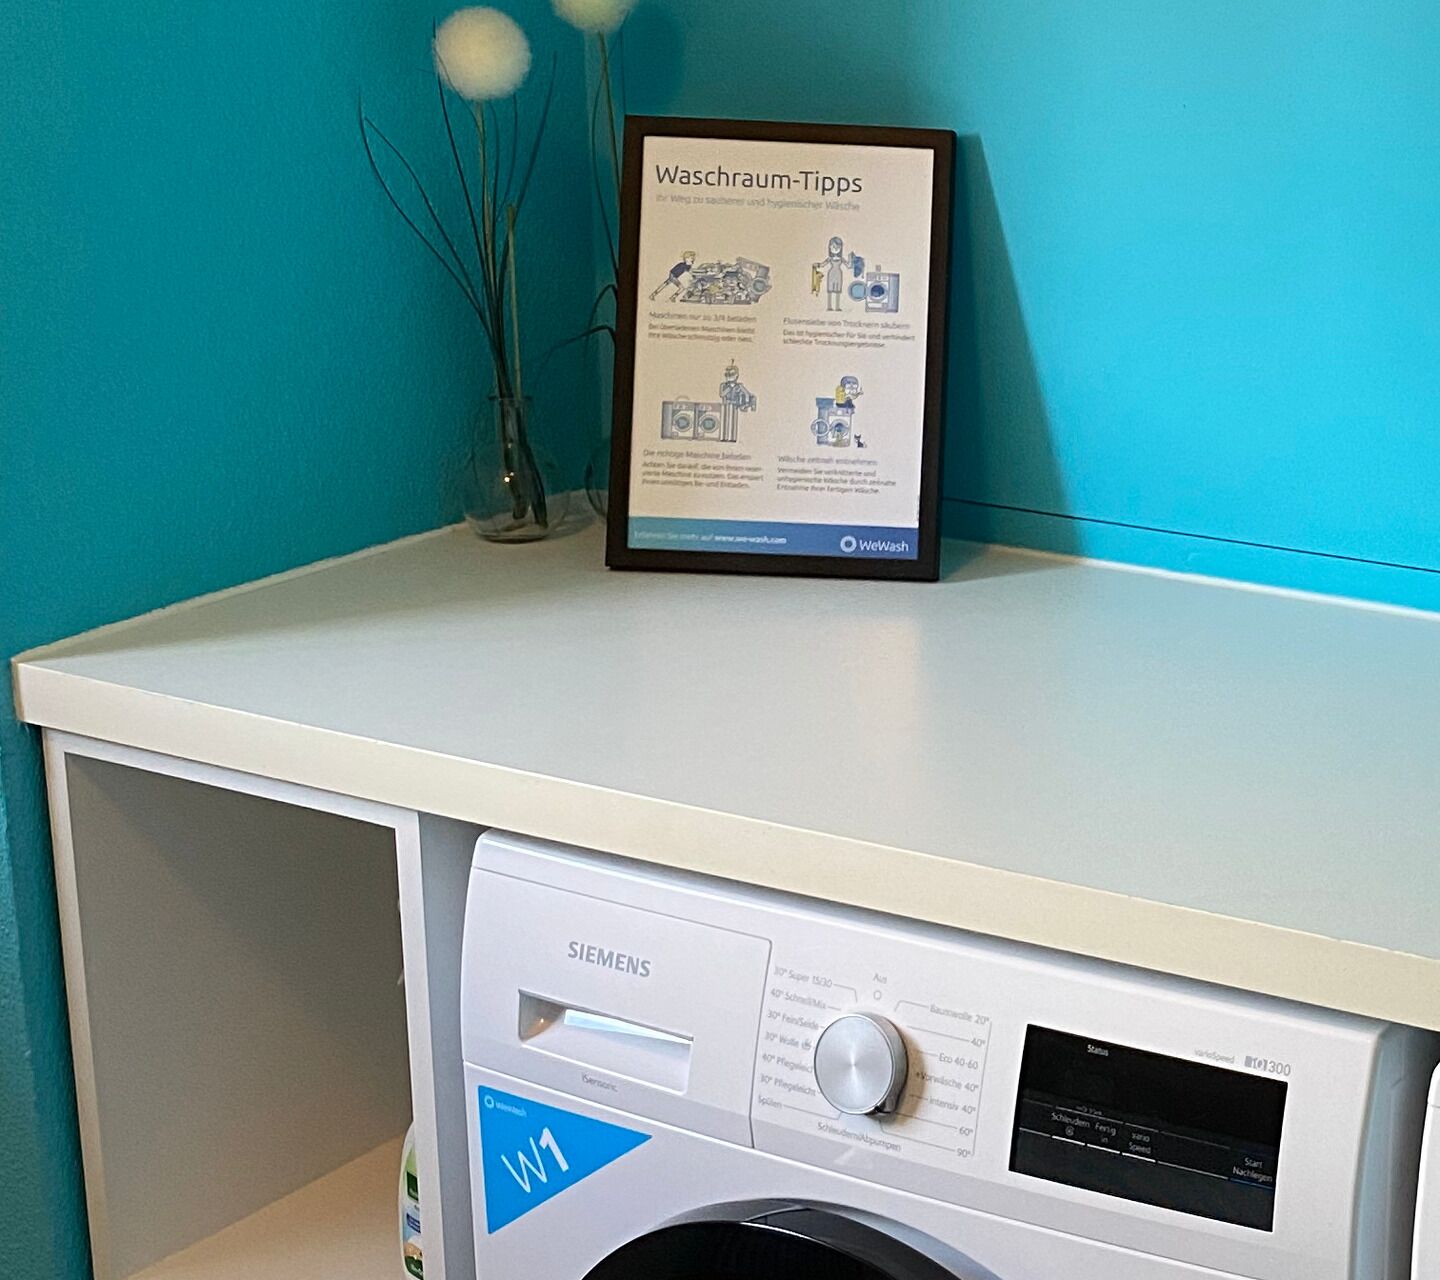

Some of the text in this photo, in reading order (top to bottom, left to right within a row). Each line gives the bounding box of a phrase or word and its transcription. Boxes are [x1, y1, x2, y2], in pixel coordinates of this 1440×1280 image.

[655, 164, 863, 196] Waschraum-Tipps
[859, 539, 909, 553] WeWash
[567, 940, 652, 978] SIEMENS
[501, 1126, 569, 1194] W1
[1244, 1156, 1264, 1169] Start
